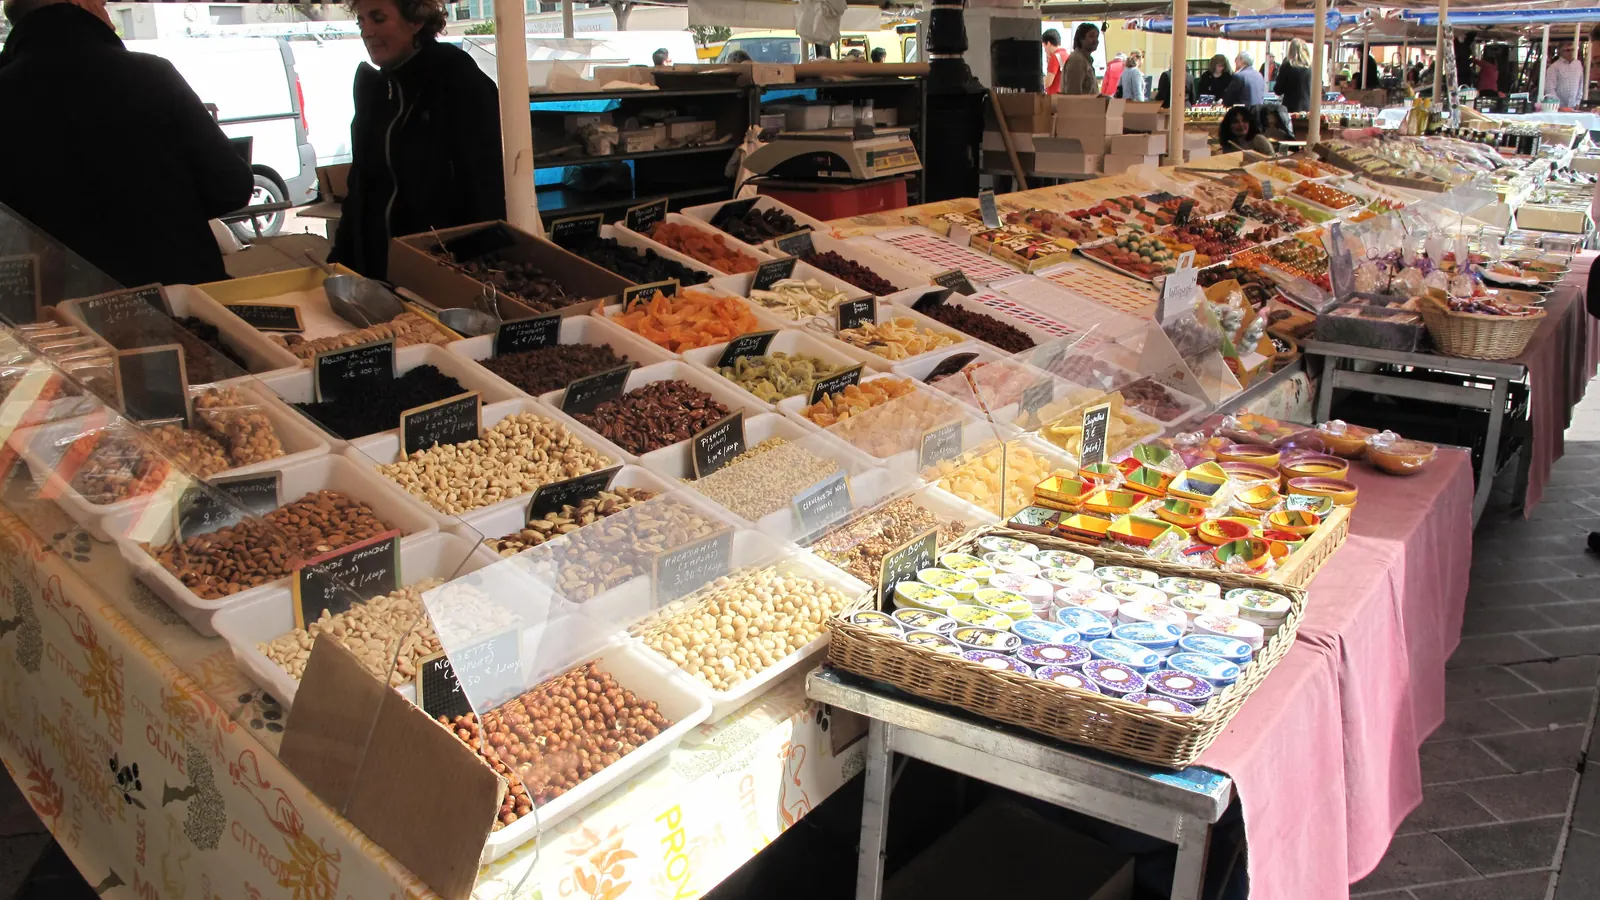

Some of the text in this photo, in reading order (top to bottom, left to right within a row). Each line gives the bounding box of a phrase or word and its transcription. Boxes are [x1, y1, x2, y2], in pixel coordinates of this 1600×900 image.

[664, 540, 718, 567] MACADAMIA
[888, 538, 926, 569] BON BON
[145, 723, 186, 776] OLIVE
